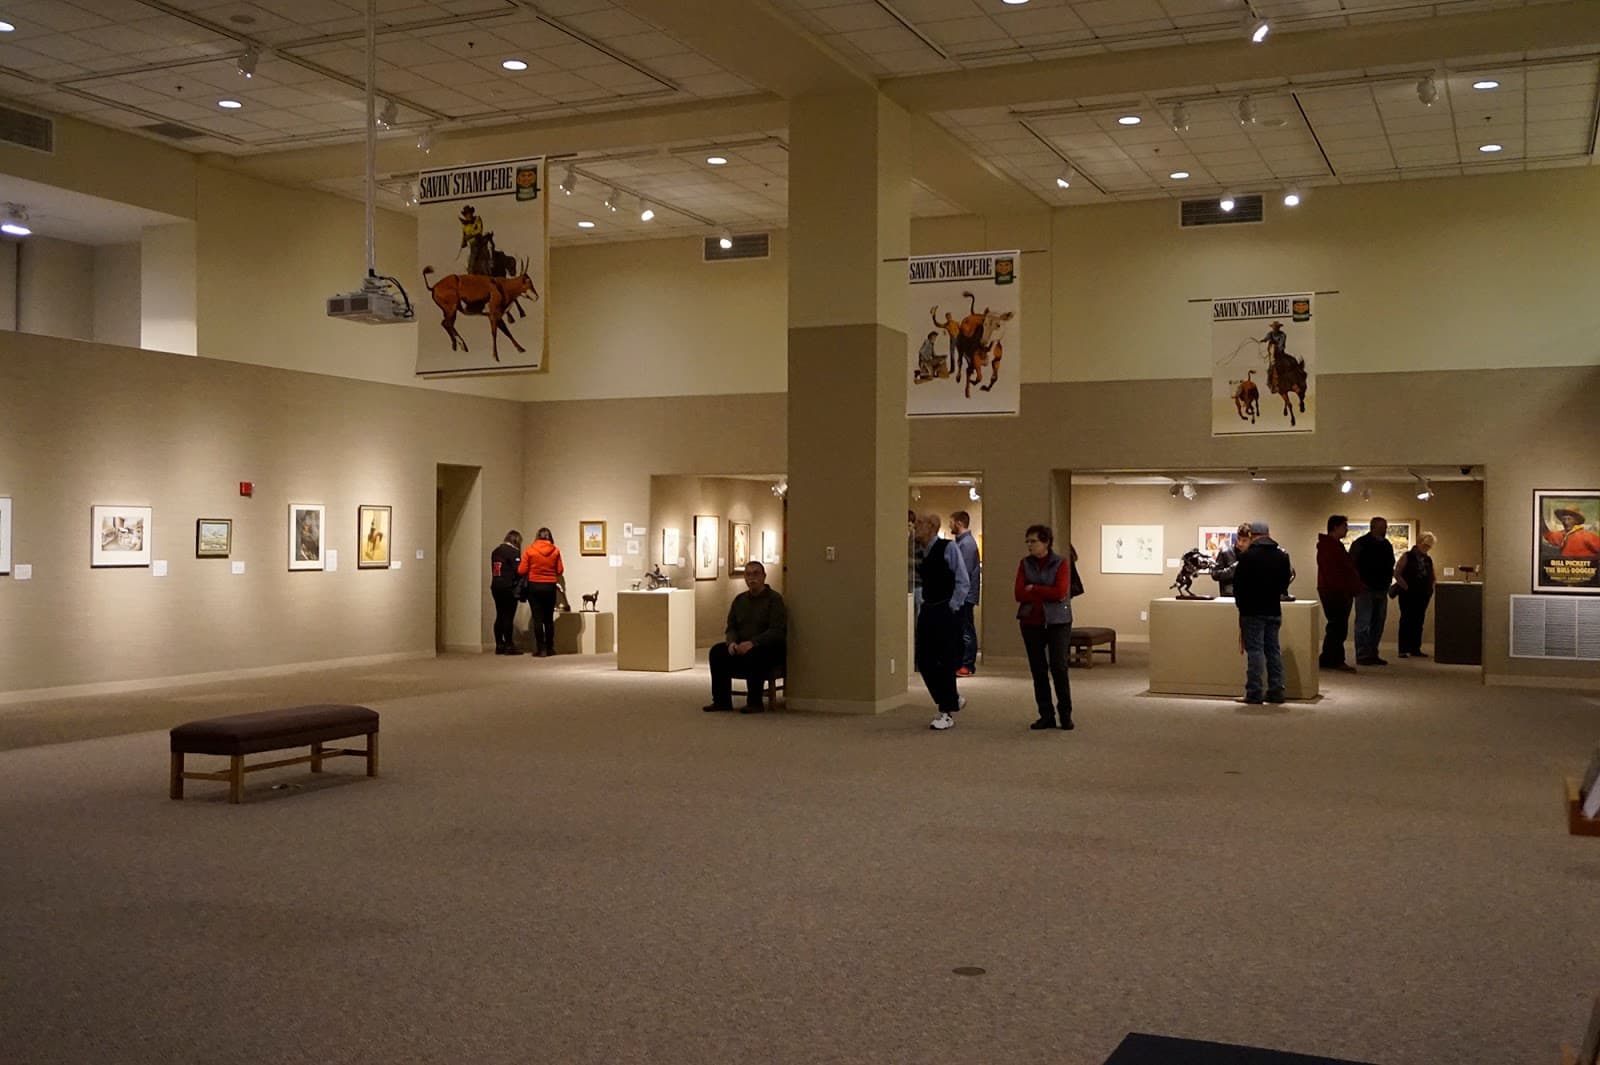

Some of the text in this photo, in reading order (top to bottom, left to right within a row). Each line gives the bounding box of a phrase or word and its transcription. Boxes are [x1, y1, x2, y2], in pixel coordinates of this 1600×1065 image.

[420, 167, 513, 199] SAVIN' STAMPEDE
[910, 258, 992, 280] SAVIN' STAMPEDE
[1214, 299, 1290, 318] SAVIN' STAMPEDE
